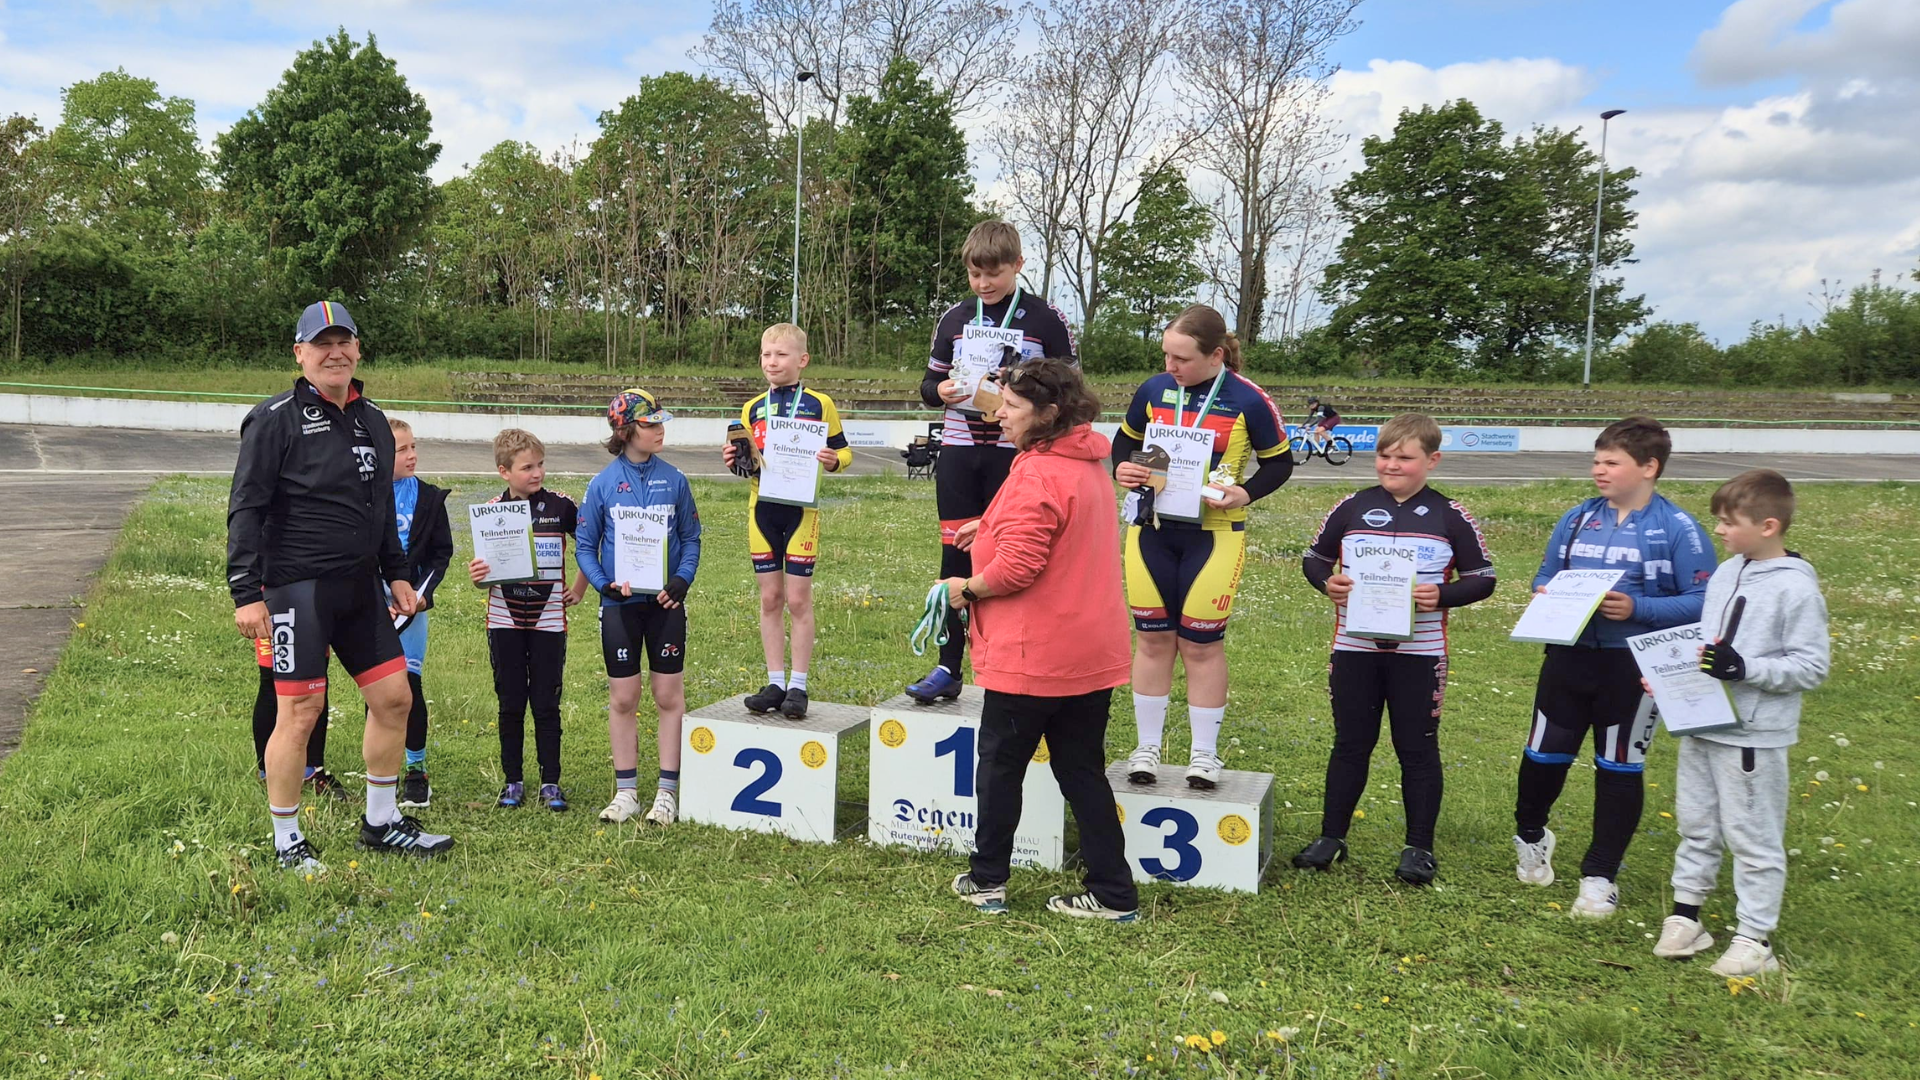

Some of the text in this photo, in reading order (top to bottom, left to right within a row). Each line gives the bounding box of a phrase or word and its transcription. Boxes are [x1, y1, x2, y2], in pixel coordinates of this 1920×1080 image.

[966, 329, 1020, 346] URKUNDE
[968, 353, 989, 363] Teiln
[770, 420, 826, 437] URKUNDE
[1149, 428, 1211, 446] URKUNDE
[772, 443, 817, 456] Teilnehmer
[1171, 456, 1201, 467] ehmer
[472, 504, 527, 518] URKUNDE
[618, 510, 666, 526] URKUNDE
[480, 528, 525, 538] Teilnehmer
[621, 533, 660, 545] Teilnehmer
[535, 542, 561, 550] TWERKE
[1355, 547, 1415, 562] URKUNDE
[1359, 572, 1409, 583] Teilnehmer
[1557, 571, 1619, 582] URKUNDE
[1548, 589, 1596, 598] Teilnehmer
[1633, 627, 1704, 652] URKUNDE
[1651, 661, 1699, 675] Teilnehm
[935, 726, 974, 797] 1
[731, 748, 783, 818] 2
[892, 798, 974, 830] Degen
[890, 830, 939, 846] Rutenweg
[1138, 806, 1203, 882] 3
